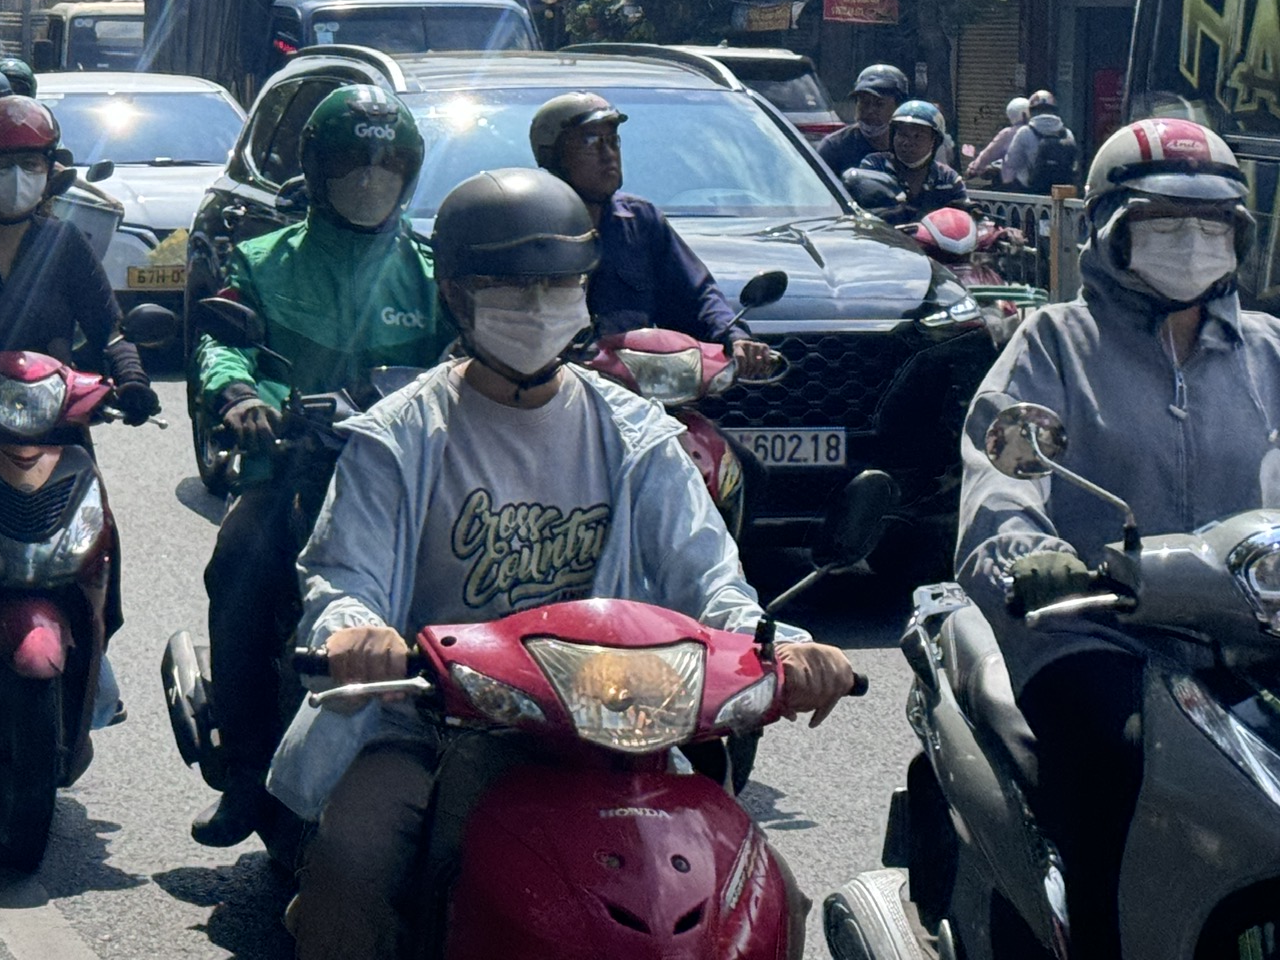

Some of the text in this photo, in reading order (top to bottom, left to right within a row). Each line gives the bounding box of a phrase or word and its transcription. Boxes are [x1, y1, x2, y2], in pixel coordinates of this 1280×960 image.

[354, 122, 396, 141] Grab
[452, 487, 563, 560] Cross
[598, 806, 673, 819] HONDA
